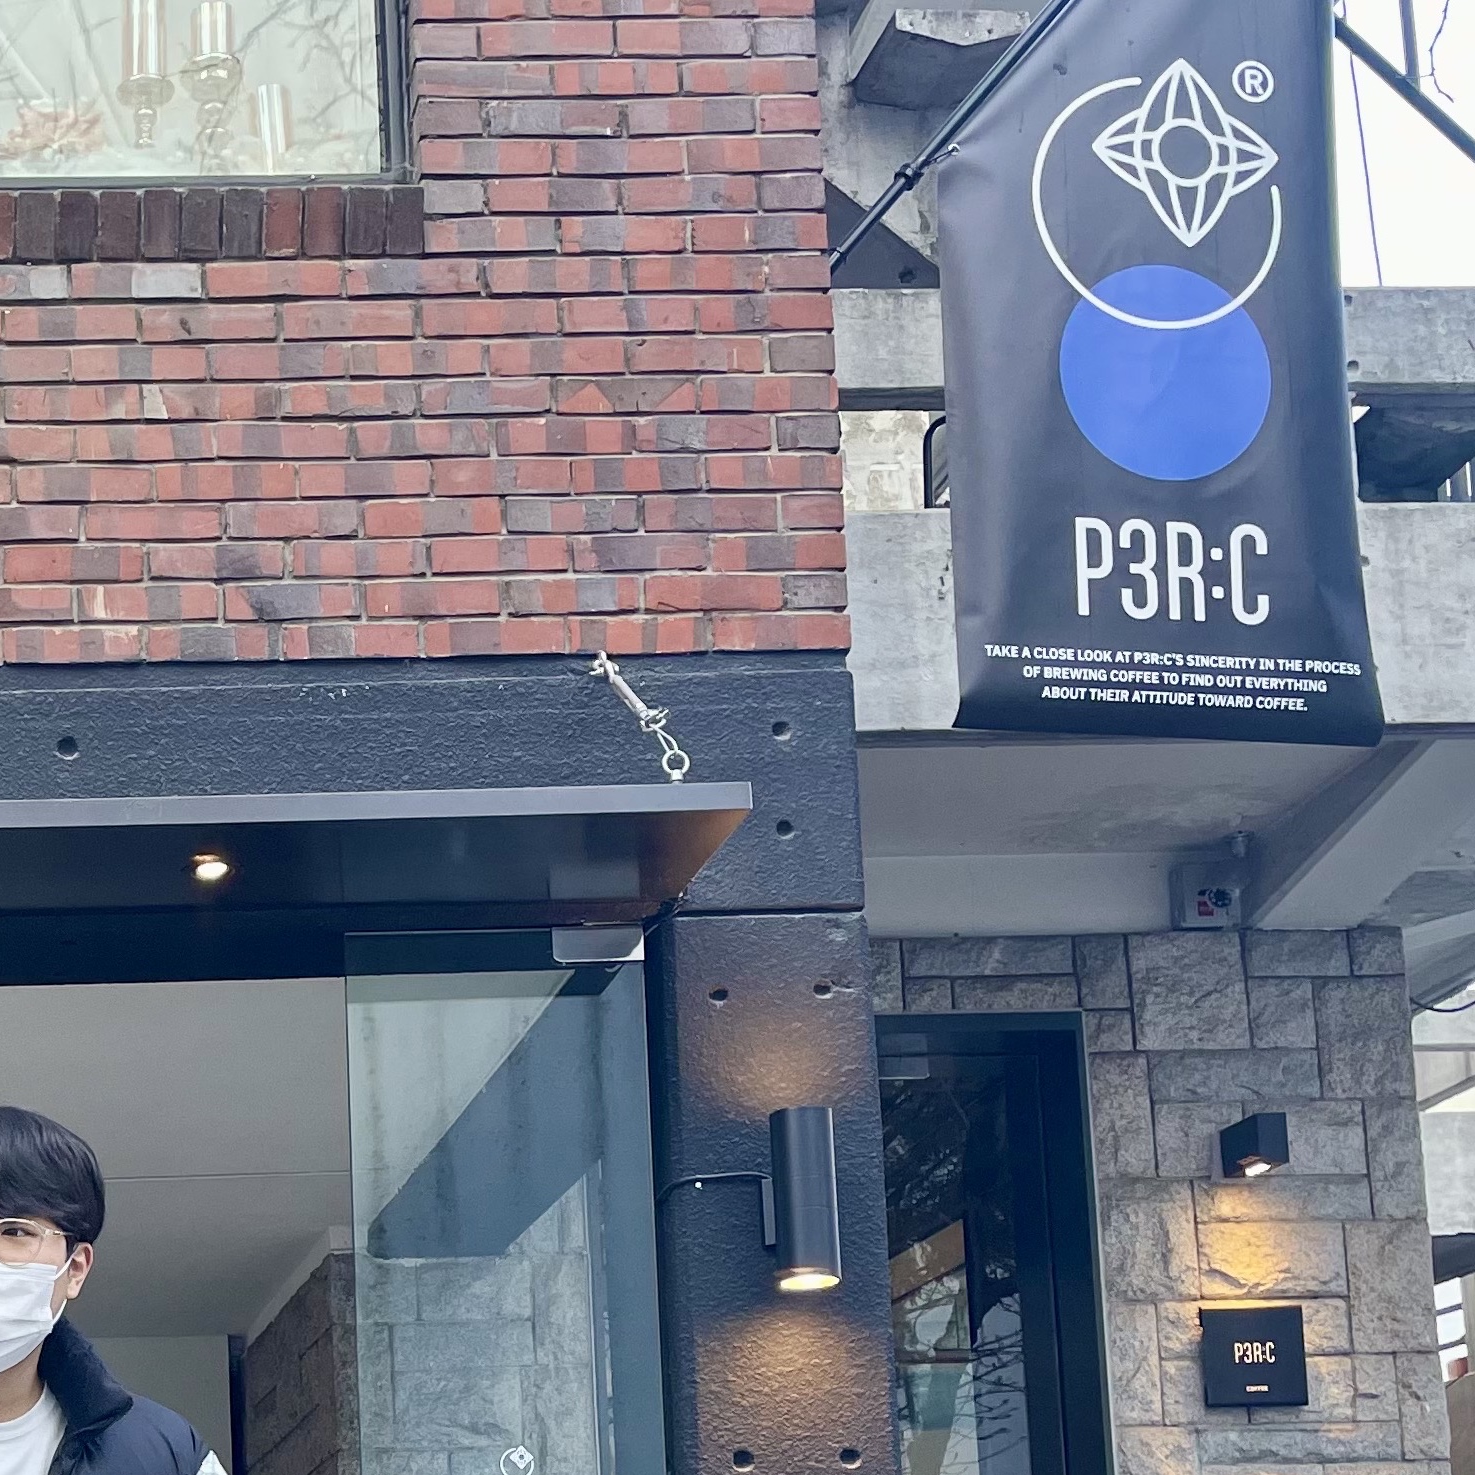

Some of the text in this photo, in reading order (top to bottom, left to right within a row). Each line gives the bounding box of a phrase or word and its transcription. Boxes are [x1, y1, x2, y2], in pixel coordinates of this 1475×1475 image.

[1074, 516, 1270, 626] P3R:C
[984, 644, 1361, 676] TAKE A CLOSE LOOK AT P3R:C'S SINCERITY IN THE PROCESS
[1023, 665, 1328, 693] OF BREWING COFFEE TO FIND OUT EVERYTHING
[1041, 686, 1308, 711] ABOUT THEIR ATTITUDE TOWARD COFFEE.
